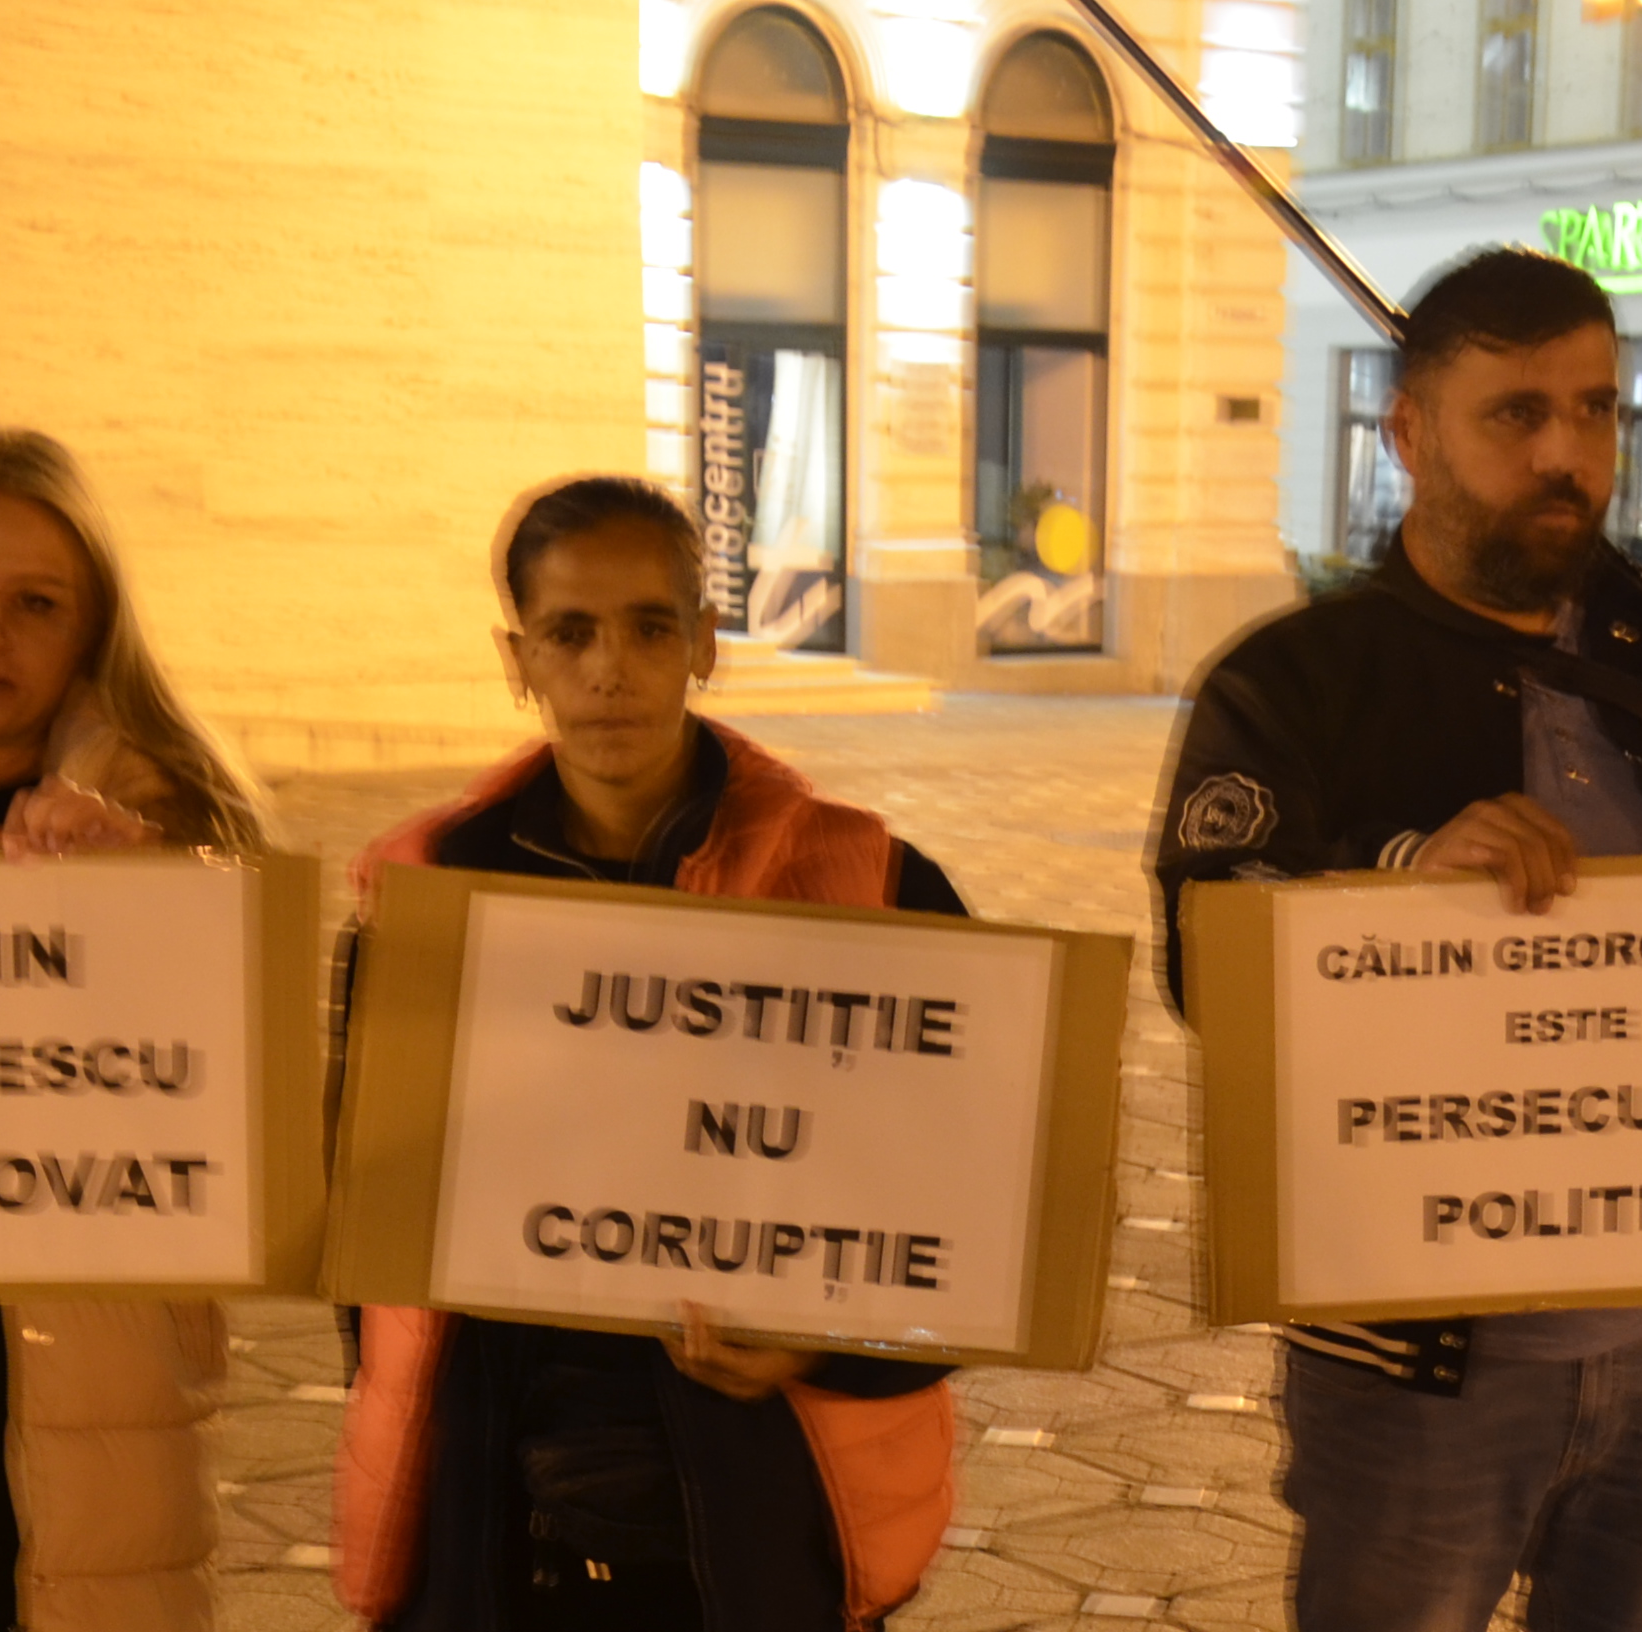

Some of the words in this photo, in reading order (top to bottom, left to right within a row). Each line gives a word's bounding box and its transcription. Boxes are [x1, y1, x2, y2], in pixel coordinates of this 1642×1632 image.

[1316, 932, 1481, 982] CĂLIN
[553, 970, 968, 1071] JUSTIȚIE
[1505, 1007, 1641, 1045] ESTE
[683, 1097, 813, 1162] NU
[523, 1203, 952, 1302] CORUPȚIE
